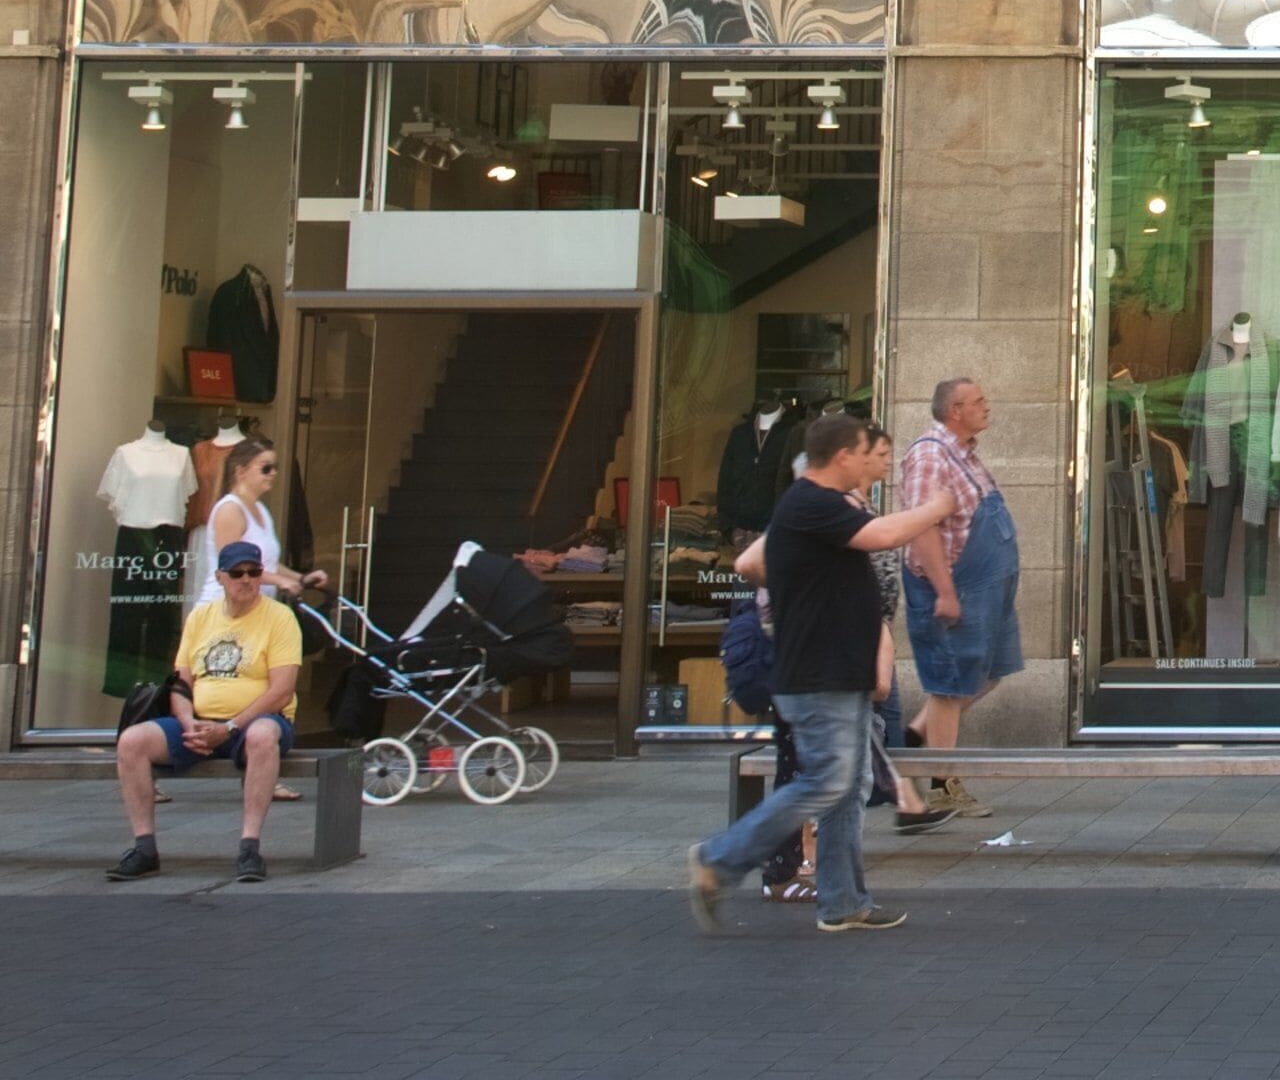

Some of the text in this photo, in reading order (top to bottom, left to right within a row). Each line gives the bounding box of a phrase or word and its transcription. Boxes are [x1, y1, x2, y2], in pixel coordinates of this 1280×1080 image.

[201, 369, 221, 380] SALE
[76, 551, 199, 569] Marc O'P
[125, 567, 178, 581] Pure
[697, 570, 749, 584] Marc
[110, 594, 197, 605] WWW.MARC-O-POLO.CO
[1155, 658, 1257, 669] SALE CONTINUES INSIDE
